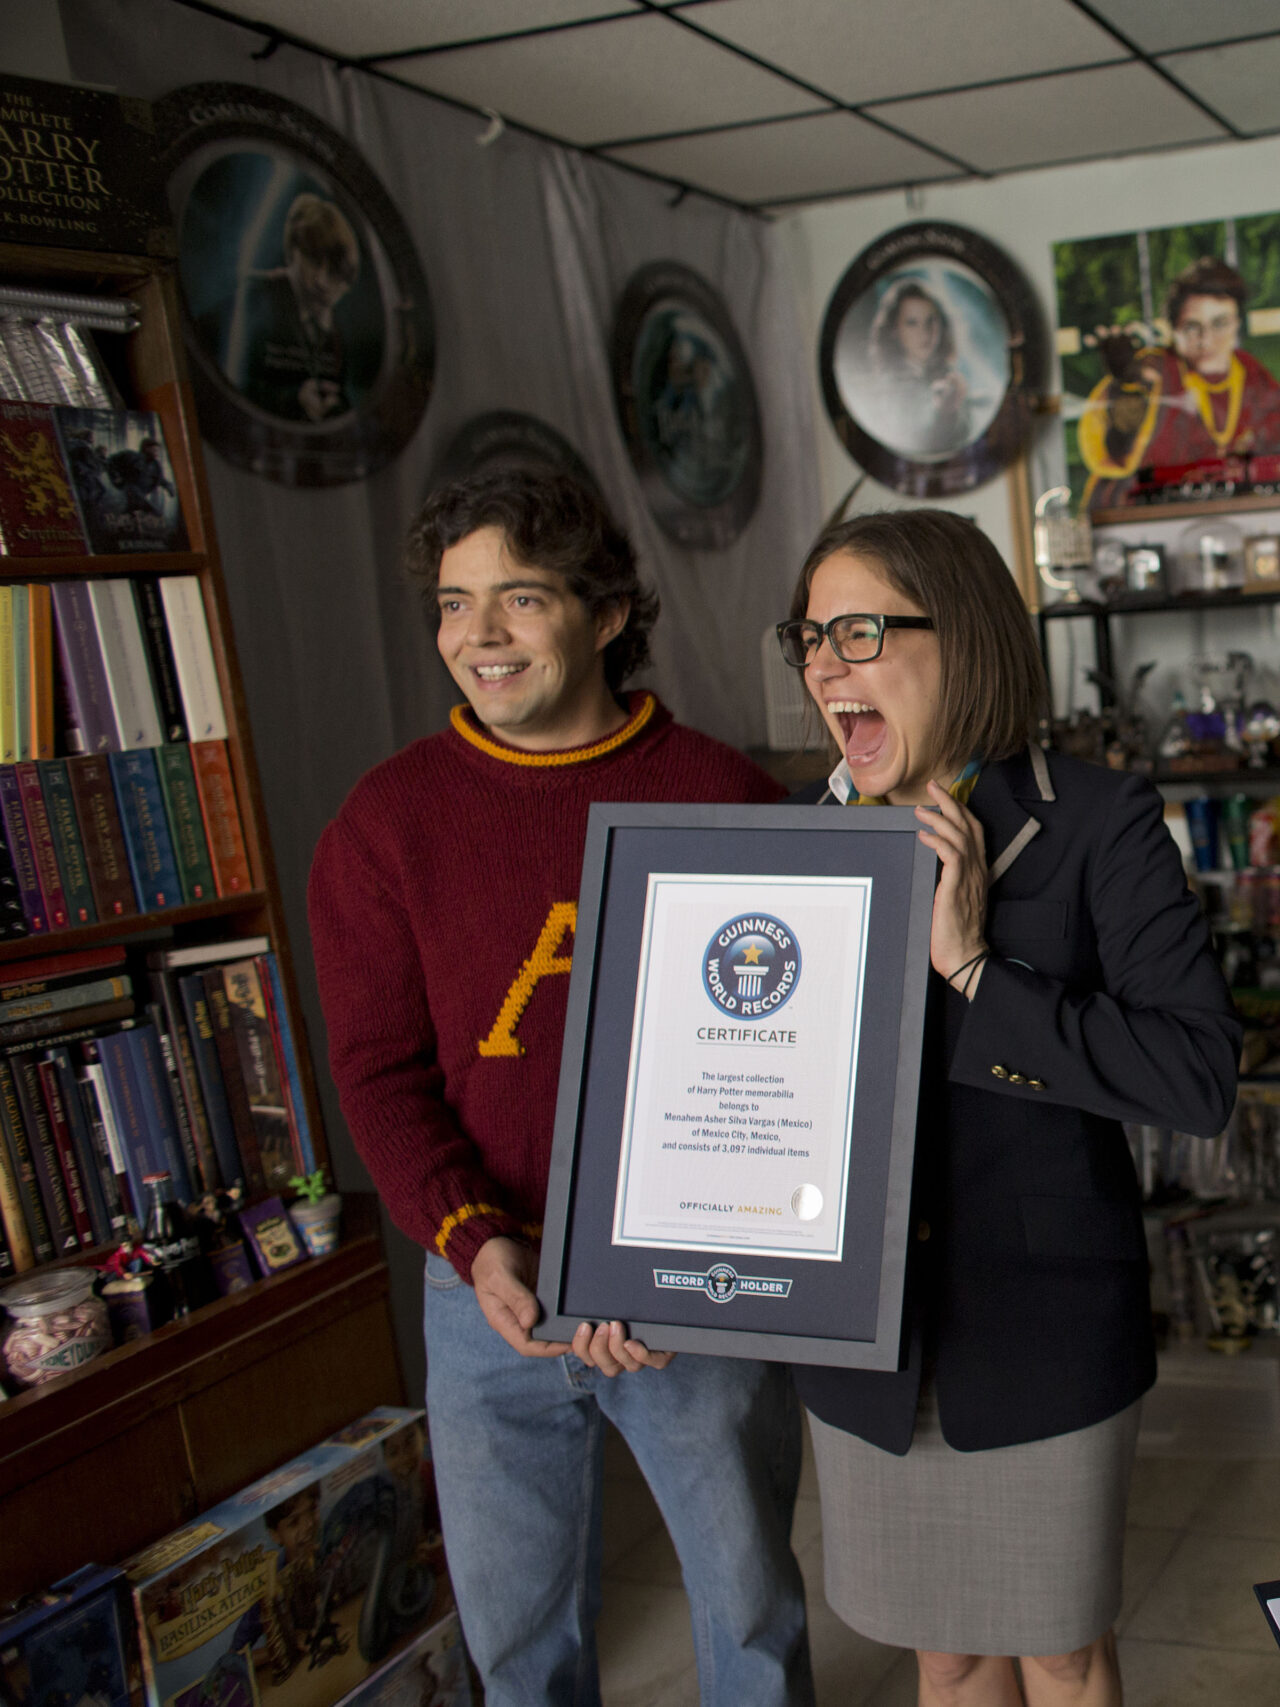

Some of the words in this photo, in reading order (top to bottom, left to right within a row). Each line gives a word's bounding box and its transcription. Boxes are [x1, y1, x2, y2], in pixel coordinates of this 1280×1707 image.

[3, 92, 33, 108] THE
[0, 107, 74, 131] MPLETE
[0, 124, 100, 165] ARRY
[0, 155, 113, 196] OTTER
[0, 186, 100, 211] OLLECTION
[20, 213, 97, 233] ROWLING
[718, 918, 791, 949] GUINNESS
[708, 958, 737, 1010] WORLD
[741, 960, 796, 1015] RECORDS
[7, 1042, 34, 1055] 2010
[36, 1029, 95, 1048] CALENDAR
[697, 1027, 797, 1043] CERTIFICATE
[702, 1071, 715, 1080] The
[717, 1072, 744, 1083] largest
[745, 1074, 785, 1084] collection
[687, 1085, 695, 1094] of
[696, 1085, 717, 1096] Harry
[719, 1087, 743, 1096] Potter
[745, 1089, 794, 1099] memorabilia
[719, 1101, 749, 1112] belongs
[751, 1103, 759, 1111] to
[4, 1094, 26, 1157] ROWLING
[664, 1112, 702, 1122] Menahem
[704, 1114, 726, 1123] Asher
[728, 1116, 747, 1125] Silva
[749, 1117, 775, 1127] Vargas
[777, 1118, 813, 1130] (Mexico)
[692, 1128, 700, 1137] of
[701, 1128, 730, 1138] Mexico
[750, 1131, 781, 1142] Mexico,
[662, 1141, 677, 1150] and
[678, 1143, 710, 1153] consists
[712, 1144, 720, 1152] of
[747, 1145, 786, 1156] individual
[787, 1147, 810, 1157] items
[679, 1201, 734, 1213] OFFICIALLY
[737, 1205, 783, 1216] AMAZING
[661, 1274, 705, 1287] RECORD
[740, 1281, 784, 1293] HOLDER
[181, 1572, 221, 1617] Harry
[220, 1544, 266, 1592] Potter
[161, 1608, 217, 1652] BASILISK
[220, 1576, 266, 1611] ATTACK
